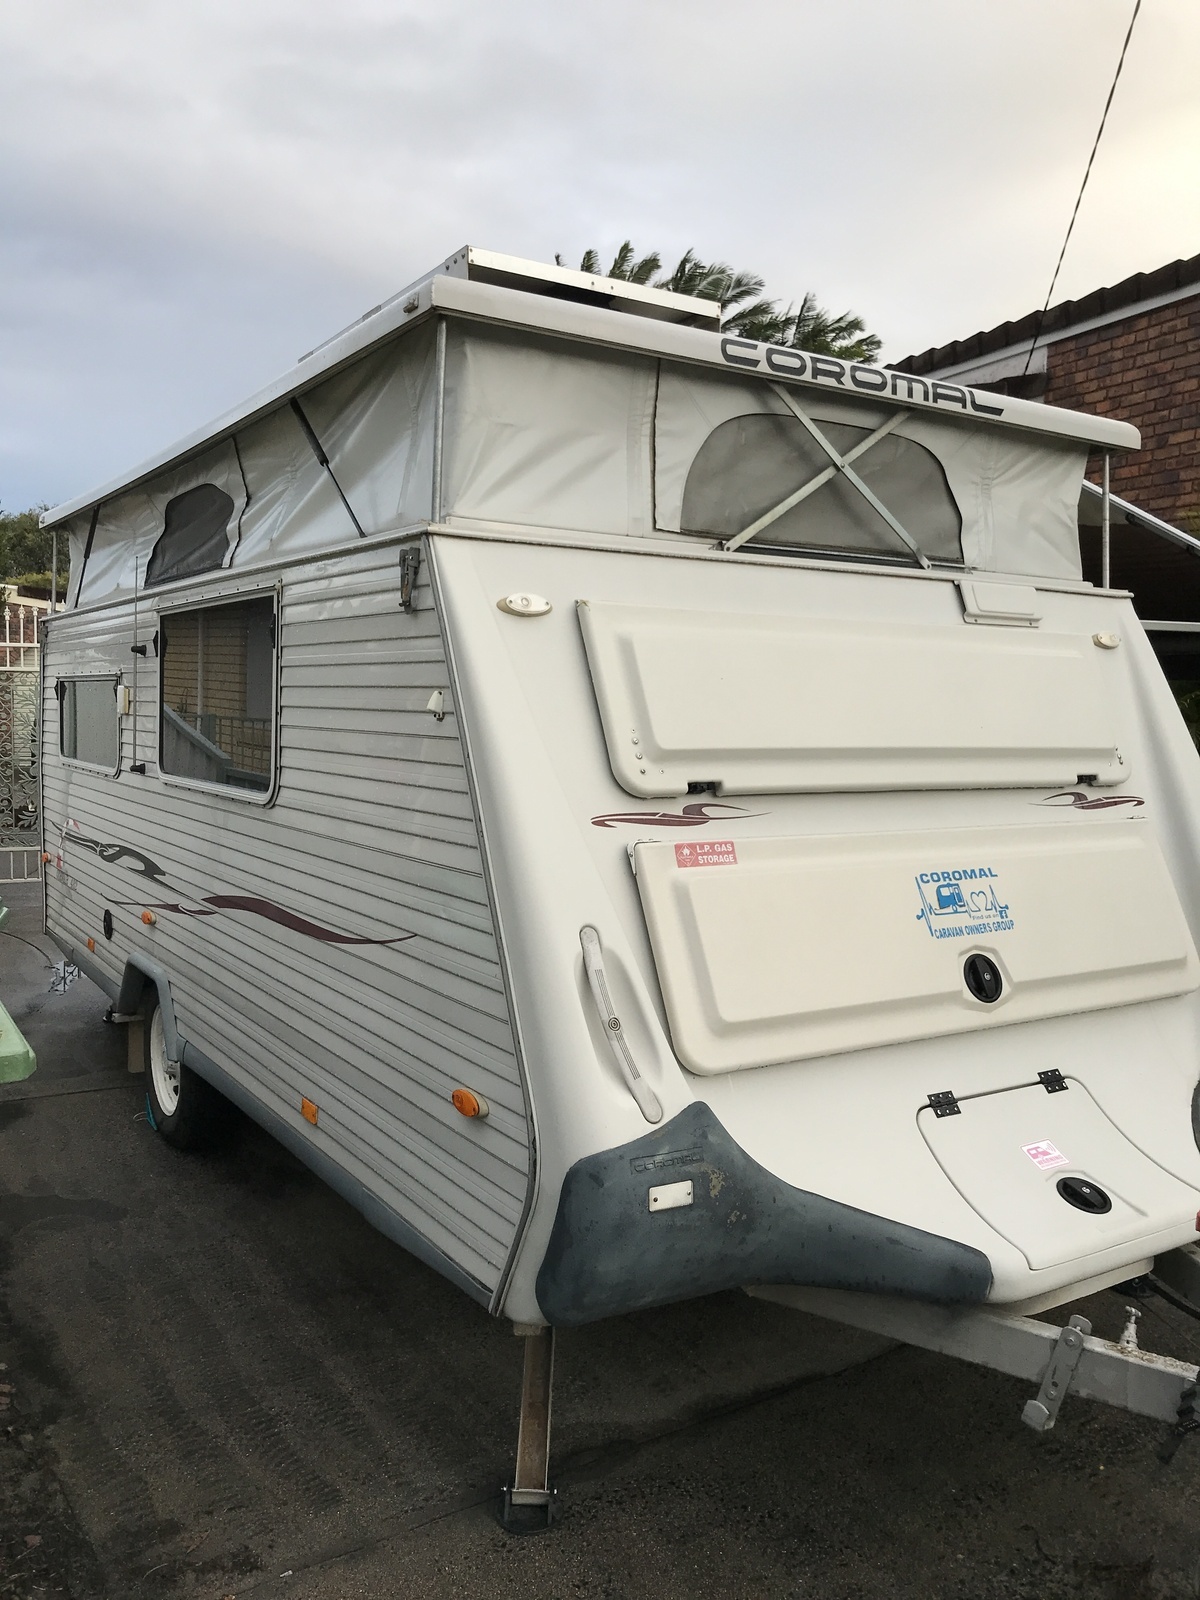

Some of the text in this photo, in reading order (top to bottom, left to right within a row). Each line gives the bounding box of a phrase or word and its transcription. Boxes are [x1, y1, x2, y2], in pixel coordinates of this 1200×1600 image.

[720, 337, 1004, 416] COROMAL
[696, 843, 733, 853] L.P. GAS
[698, 854, 735, 864] STORAGE
[919, 867, 998, 884] COROMAL
[934, 919, 1015, 940] CARAVAN OWNERS GROUP
